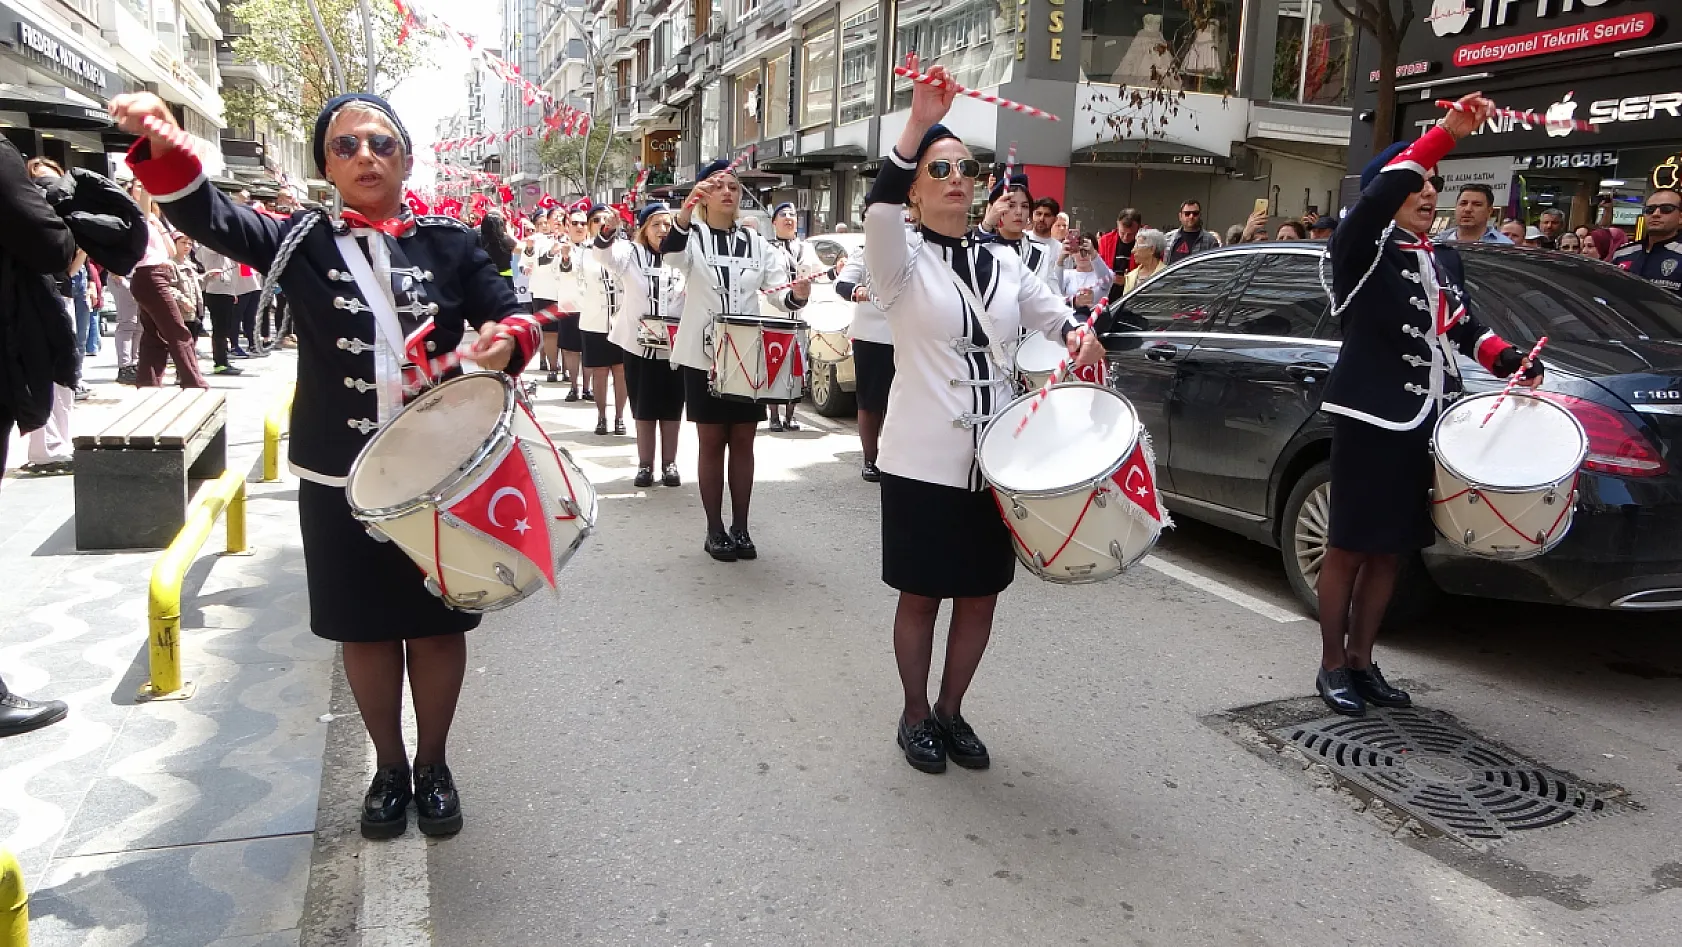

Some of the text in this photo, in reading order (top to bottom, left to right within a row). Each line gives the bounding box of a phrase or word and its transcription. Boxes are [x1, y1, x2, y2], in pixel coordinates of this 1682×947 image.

[1048, 0, 1064, 60] SE
[1457, 18, 1645, 62] Profesyonel Teknik Servis
[1173, 155, 1214, 165] PENTI
